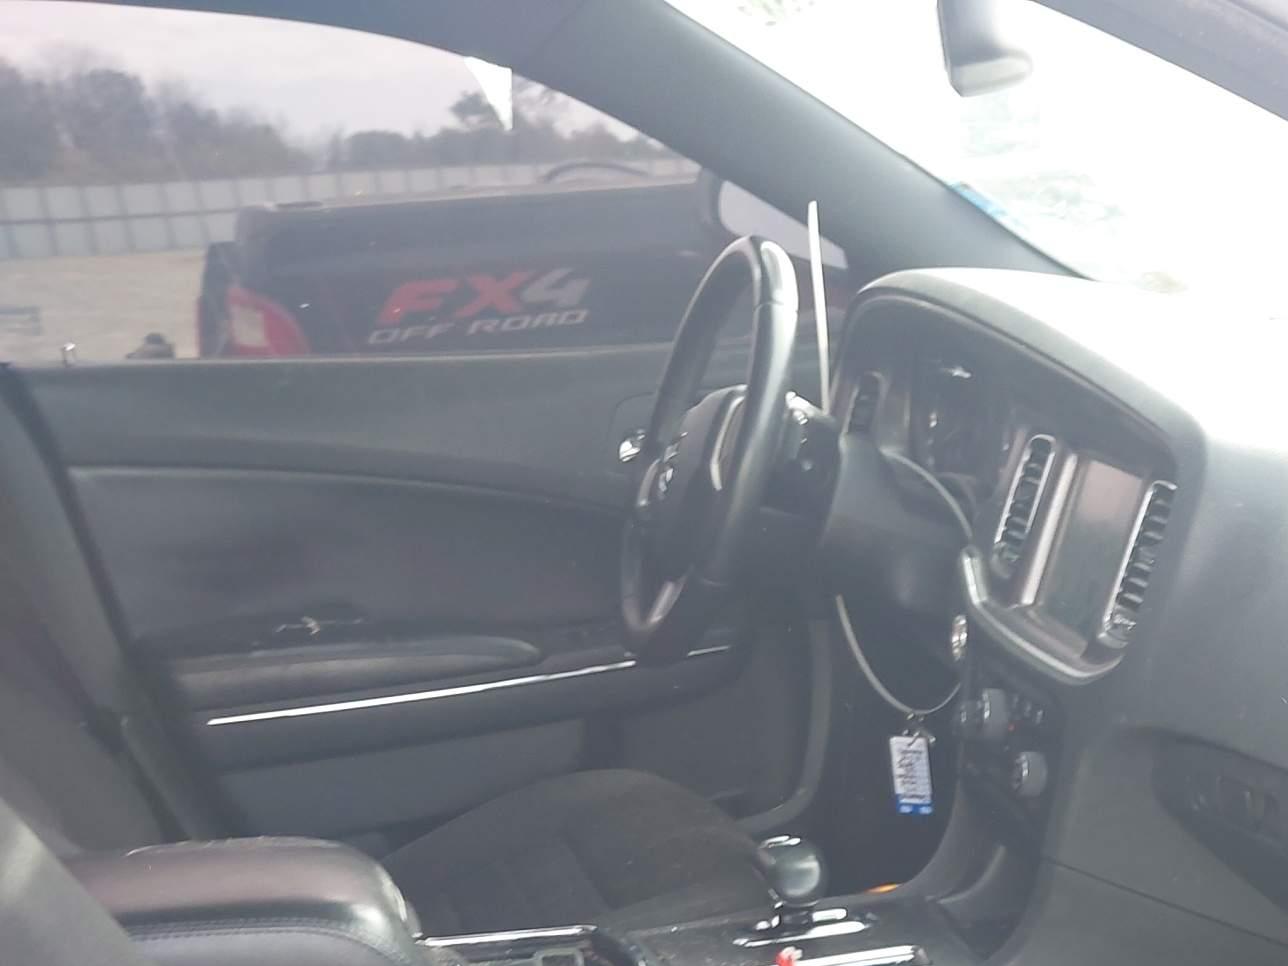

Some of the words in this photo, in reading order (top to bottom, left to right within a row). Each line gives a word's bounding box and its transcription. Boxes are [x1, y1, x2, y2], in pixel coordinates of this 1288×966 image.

[377, 268, 592, 325] FX4
[368, 323, 455, 344] OFF
[468, 308, 590, 335] ROAD
